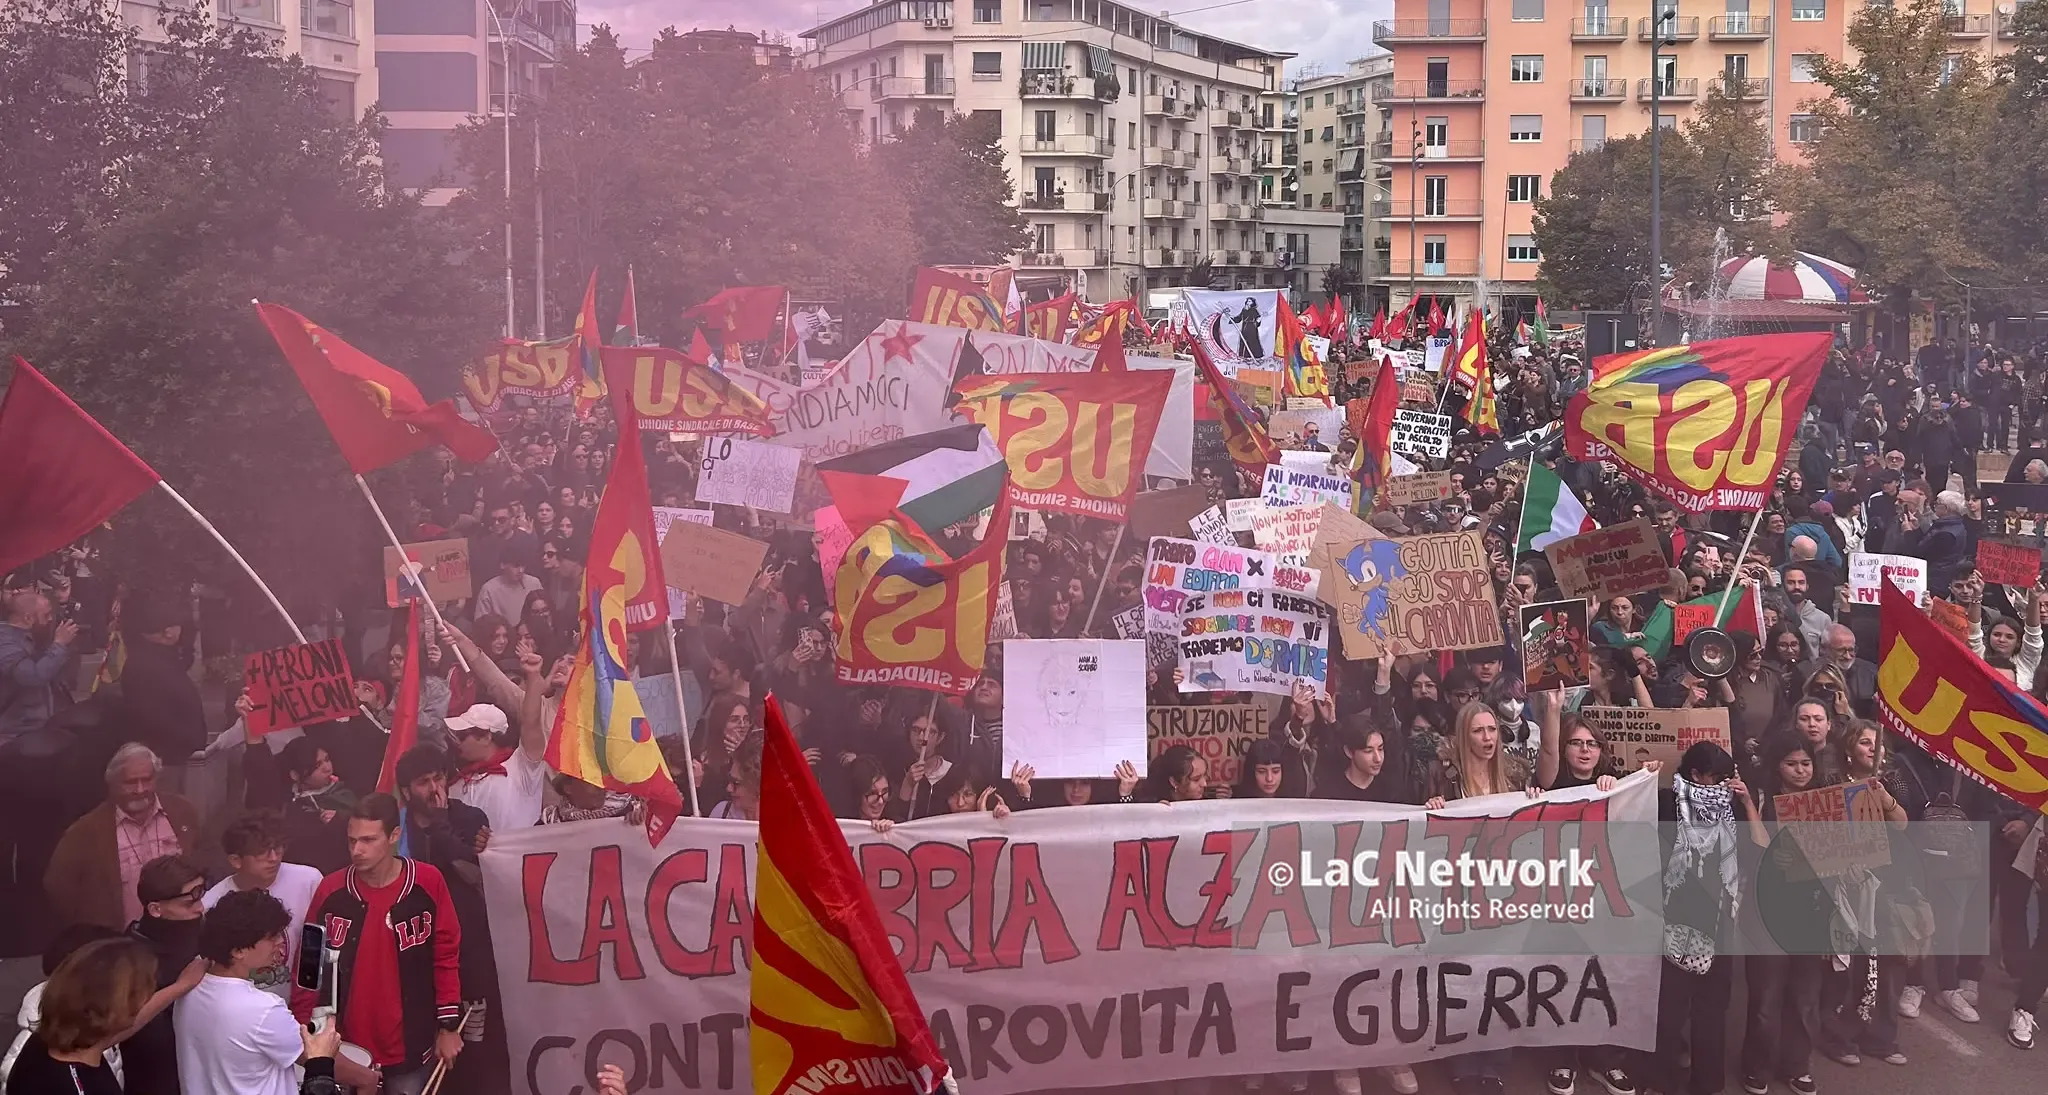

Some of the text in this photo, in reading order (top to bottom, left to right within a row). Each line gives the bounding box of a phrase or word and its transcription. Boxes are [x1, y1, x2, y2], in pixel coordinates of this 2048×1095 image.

[1391, 422, 1412, 433] MENO
[1400, 411, 1450, 428] GOVERNO HA
[1397, 431, 1443, 446] DI ASCOLTO
[1392, 441, 1408, 452] DEL
[1428, 446, 1443, 457] EX
[1410, 486, 1438, 500] MELONI
[1202, 546, 1244, 574] GLAM
[1400, 533, 1479, 573] GOTTA
[1148, 564, 1176, 587] UN
[1400, 569, 1489, 604] GO STOP
[1857, 586, 1916, 604] FUTO
[1184, 594, 1206, 614] SE
[1212, 590, 1243, 608] NON
[1271, 592, 1329, 619] FARETE
[1181, 614, 1256, 637] SOGNARE
[1261, 615, 1295, 638] NON
[1405, 600, 1499, 650] CAROVITA
[1180, 636, 1329, 682] FAREMO DORMIRE
[1582, 710, 1600, 719] OH
[1604, 710, 1624, 719] MIO
[1626, 721, 1661, 731] UCCISO
[1677, 726, 1721, 739] BRUTTI
[1600, 730, 1676, 743] OSTRO DIRITTO
[645, 837, 1080, 981] CABRIA
[1097, 820, 1319, 950] ALZA
[527, 958, 1618, 1095] CONT AROVITA E GUERRA
